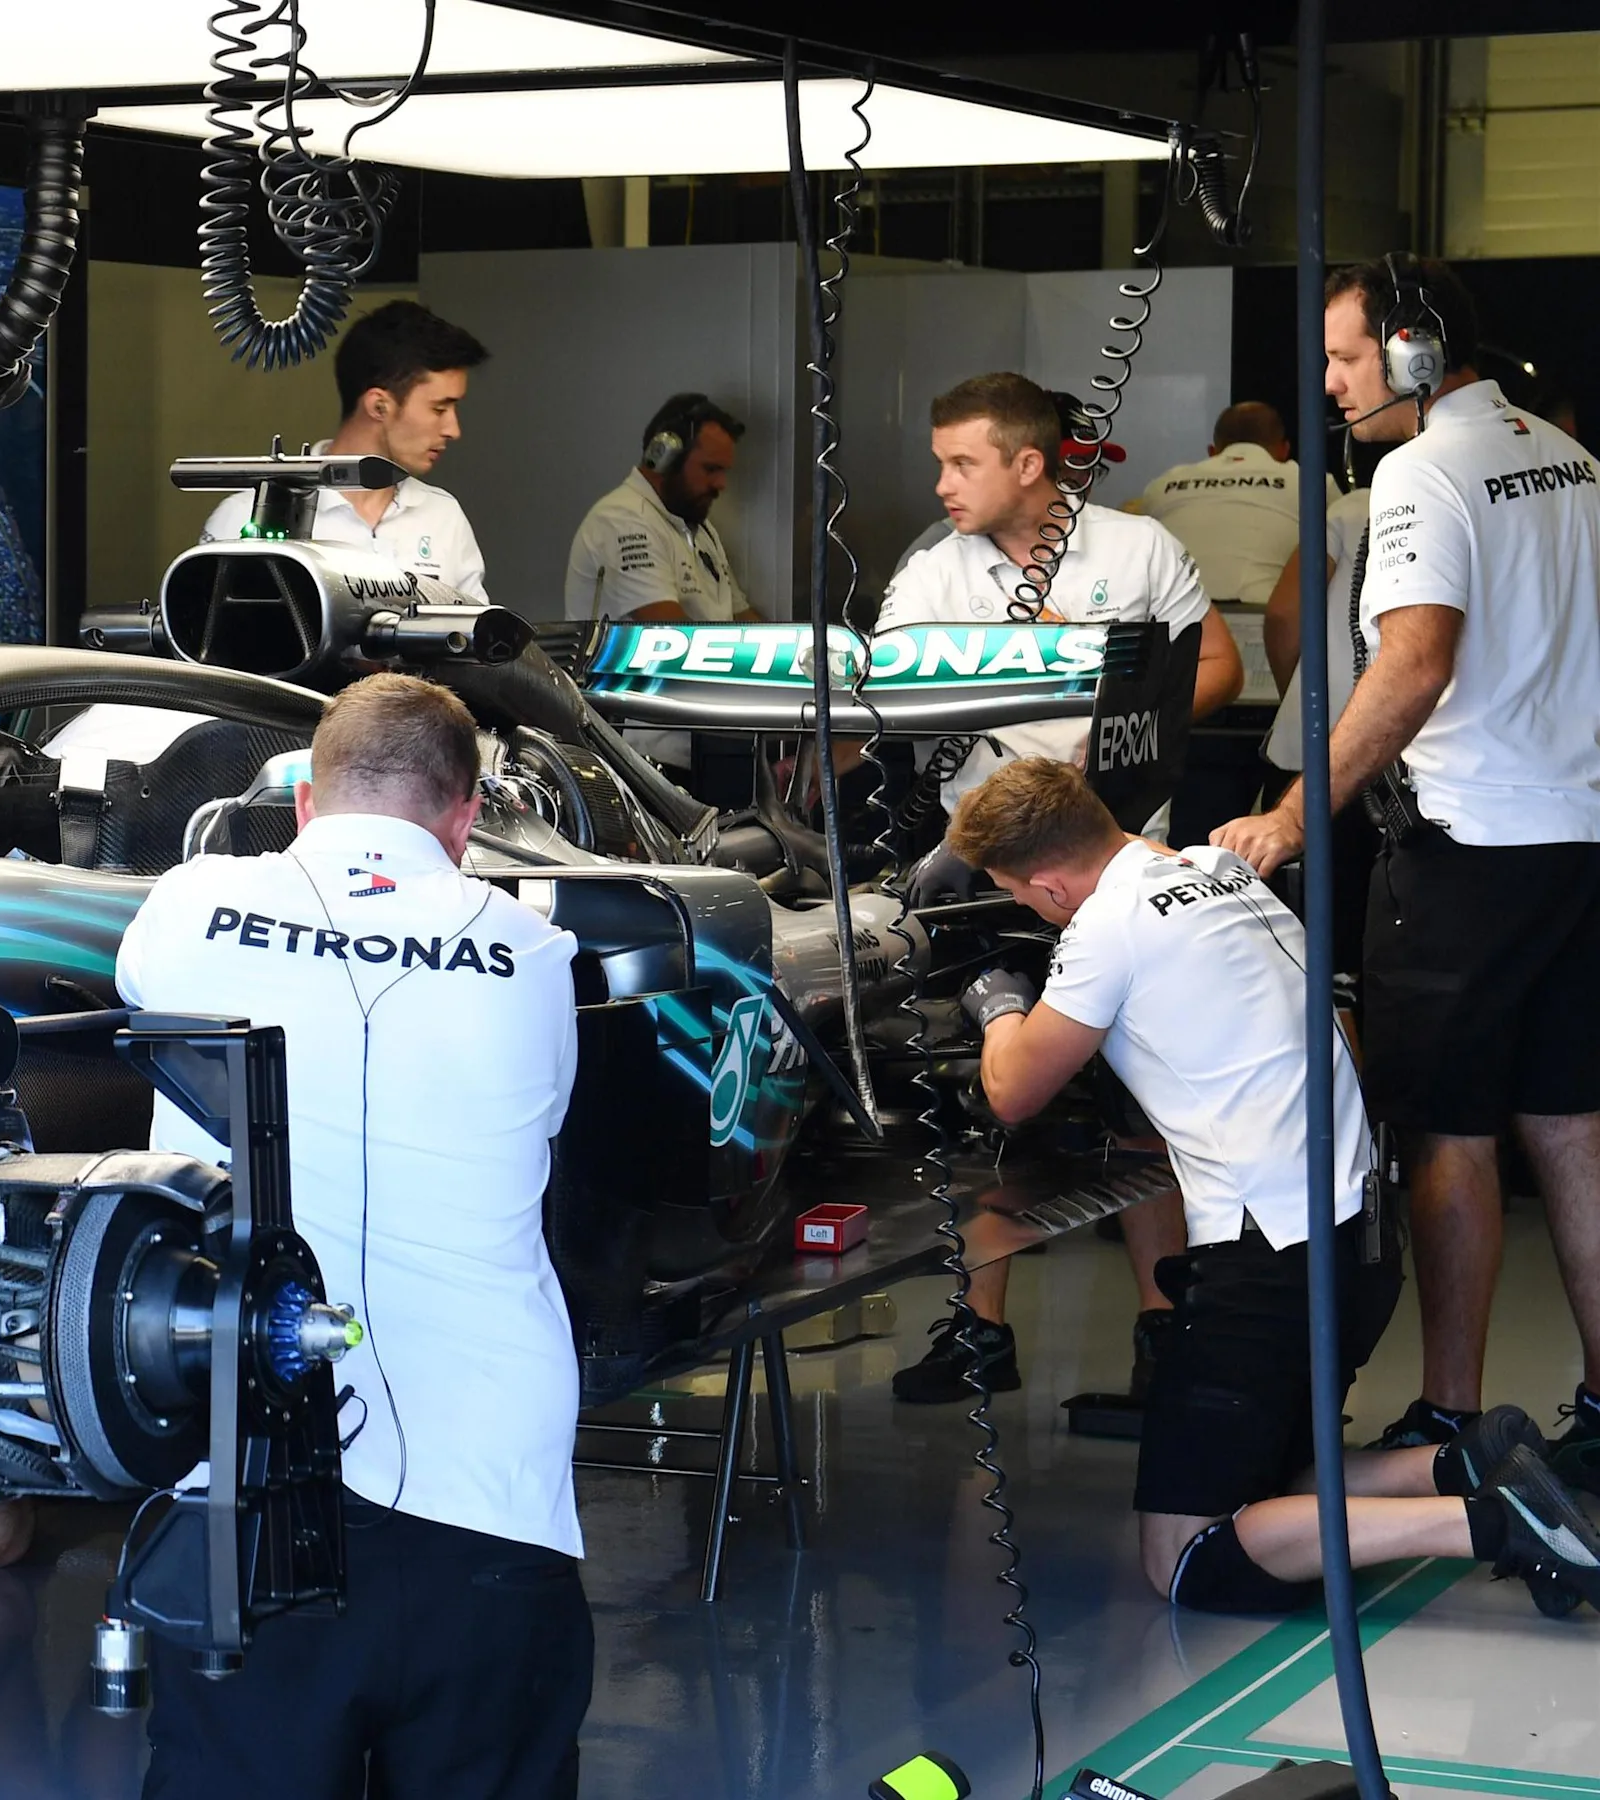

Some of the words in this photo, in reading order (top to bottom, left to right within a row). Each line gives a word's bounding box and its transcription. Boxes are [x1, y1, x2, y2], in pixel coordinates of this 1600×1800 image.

[1164, 476, 1286, 494] PETRONAS
[1483, 460, 1596, 505] PETRONAS
[1376, 504, 1415, 527] EPSON
[1382, 536, 1409, 554] IWC
[1098, 708, 1160, 771] EPSON
[205, 906, 515, 979] PETRONAS
[810, 1228, 828, 1239] Left
